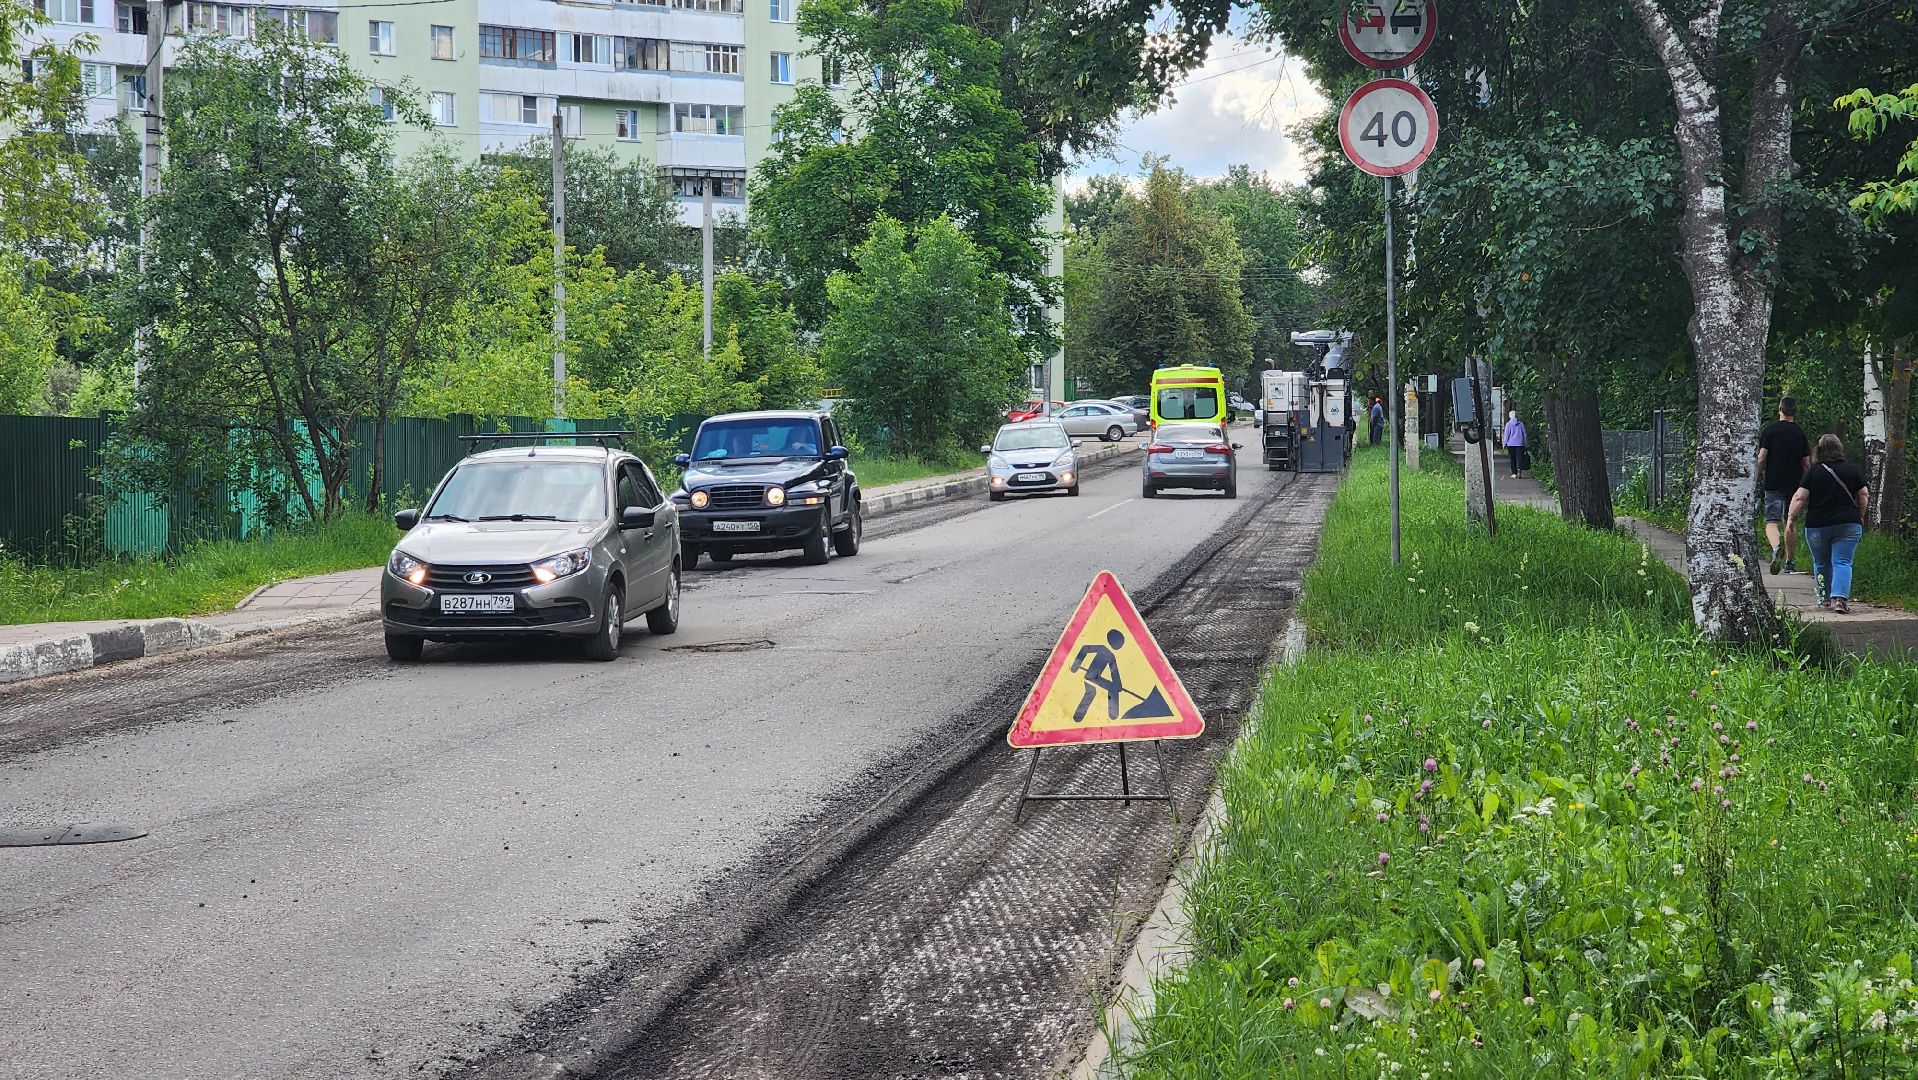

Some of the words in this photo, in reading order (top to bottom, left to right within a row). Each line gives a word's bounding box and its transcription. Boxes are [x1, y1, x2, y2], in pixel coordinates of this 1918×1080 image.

[1359, 110, 1416, 148] 40
[444, 597, 491, 609] В287НН
[492, 596, 511, 606] 799
